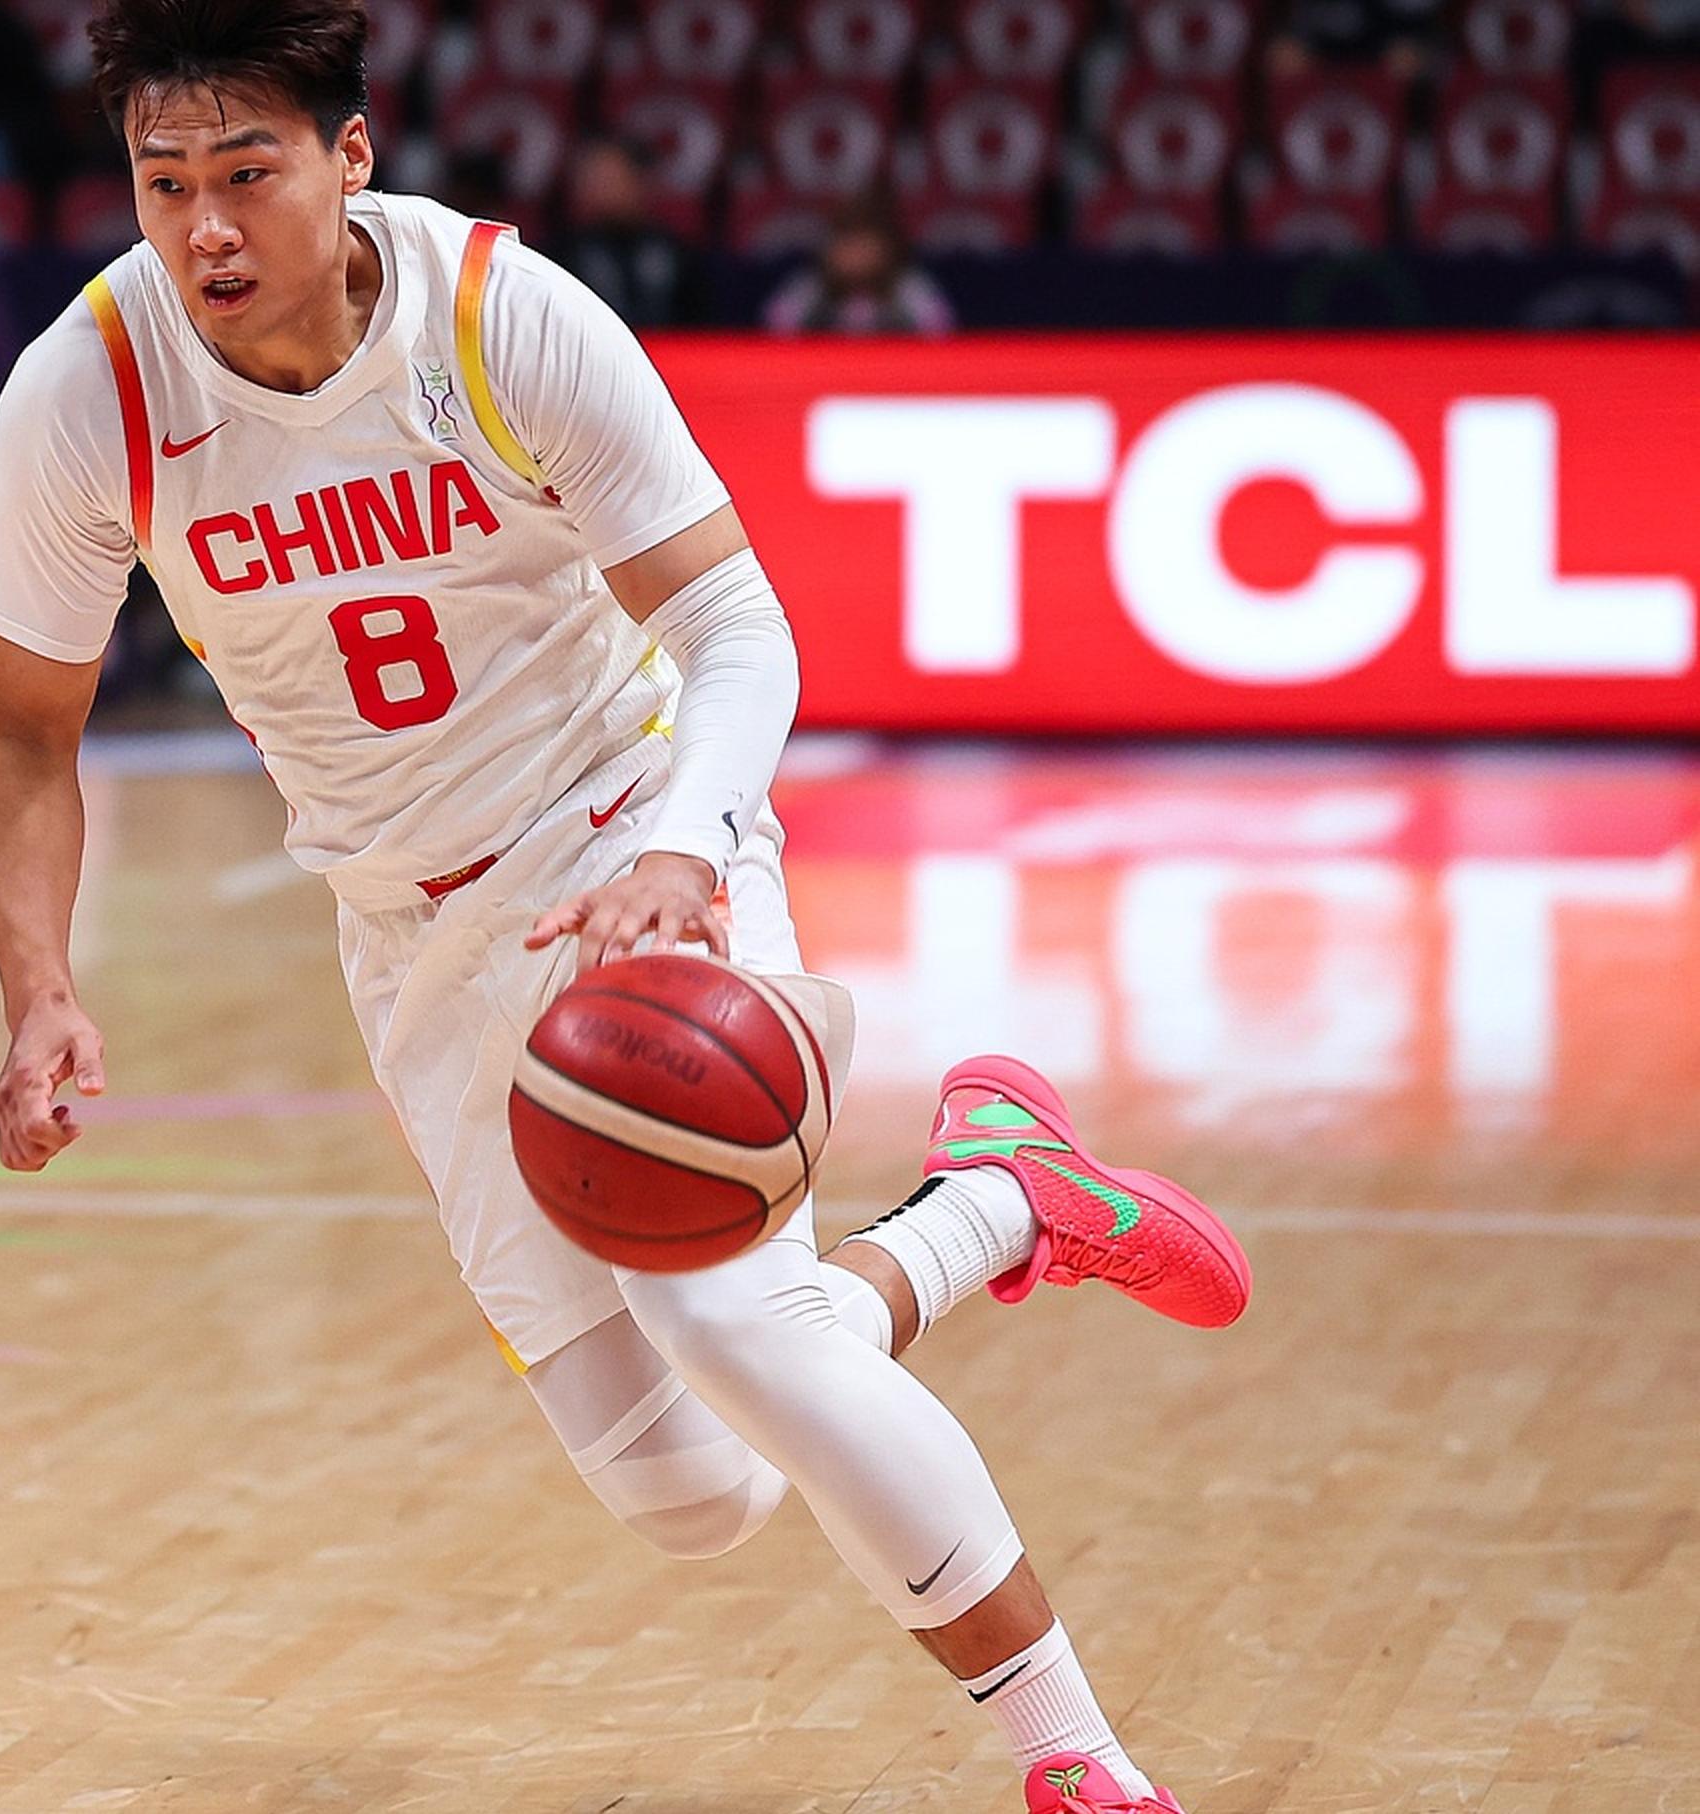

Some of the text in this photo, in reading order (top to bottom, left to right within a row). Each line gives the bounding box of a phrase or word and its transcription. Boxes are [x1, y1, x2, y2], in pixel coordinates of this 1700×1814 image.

[186, 460, 501, 595] CHINA
[804, 382, 1695, 683] TCL
[328, 595, 459, 732] 8
